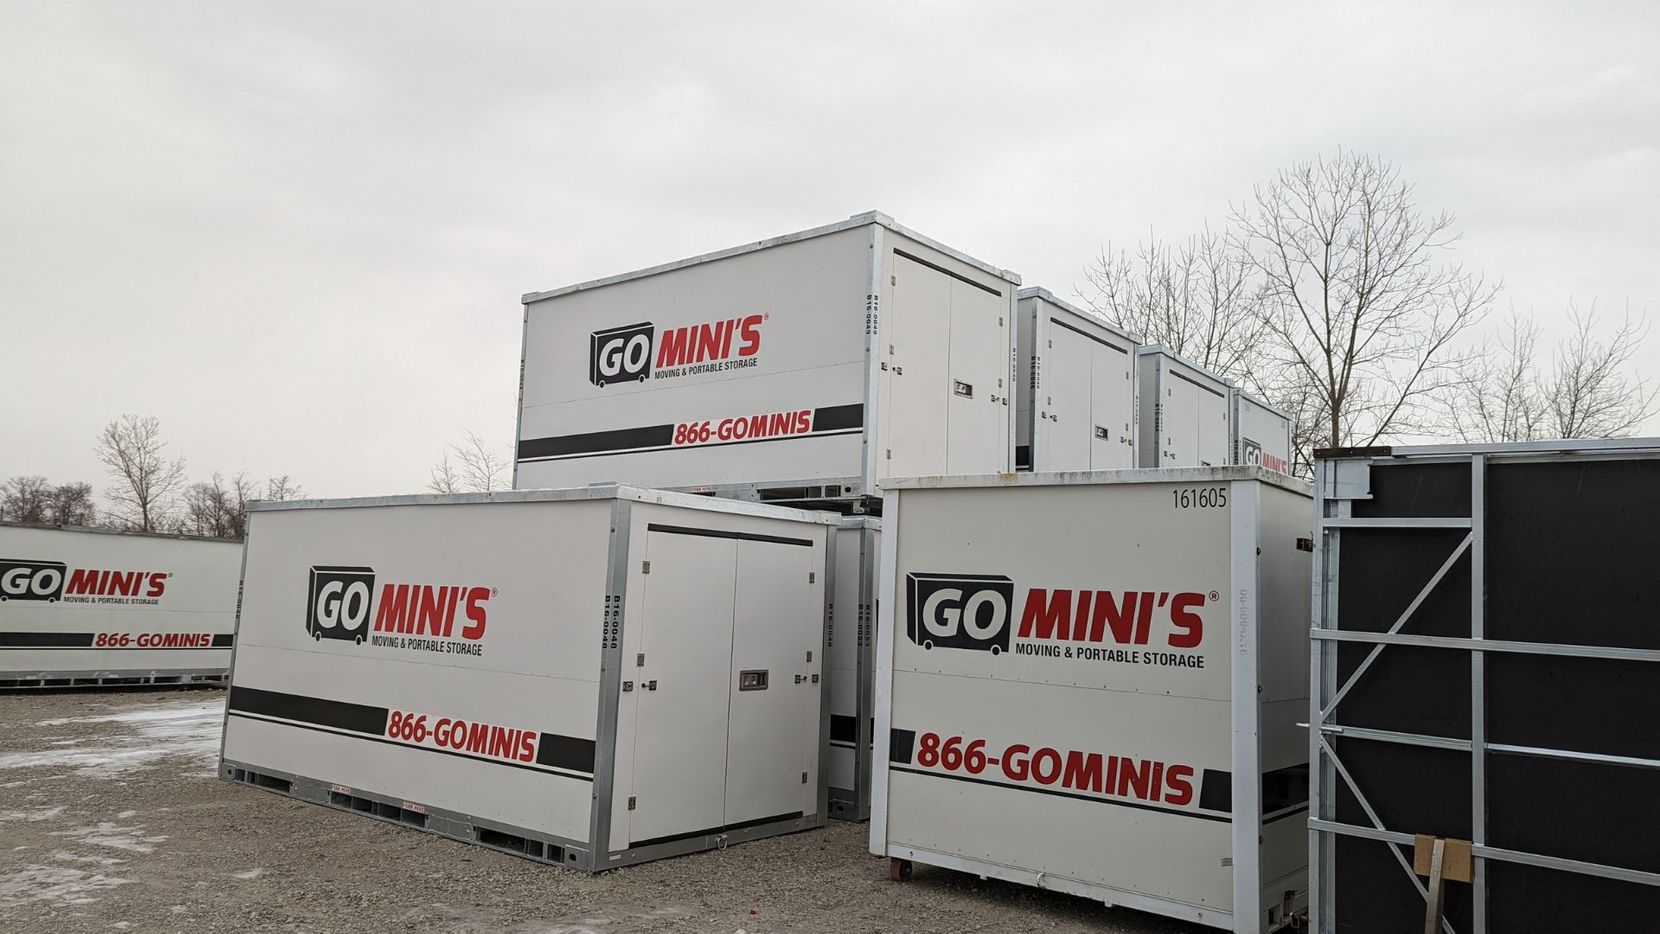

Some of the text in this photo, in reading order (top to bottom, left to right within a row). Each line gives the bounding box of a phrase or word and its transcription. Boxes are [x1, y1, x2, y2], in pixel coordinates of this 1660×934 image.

[599, 333, 650, 377] GO
[654, 358, 758, 380] MOVING & PORTABLE STORAGE
[674, 410, 811, 445] 866-GOMINIS
[1172, 487, 1227, 509] 161605
[1, 567, 62, 596] GO
[63, 596, 90, 604] MOVING
[97, 597, 130, 605] PORTABLE
[130, 598, 160, 606] STORAGE
[316, 580, 370, 631] GO
[922, 587, 1007, 640] GO
[602, 595, 611, 649] B16-0048
[610, 595, 621, 649] B16-0048
[95, 632, 211, 648] 866-GOMINIS
[371, 635, 483, 656] MOVING & PORTABLE STORAGE
[1015, 642, 1205, 669] MOVING & PORTABLE STORAGE
[388, 710, 536, 763] 866-GOMINIS
[917, 732, 1194, 806] 866-GOMINIS
